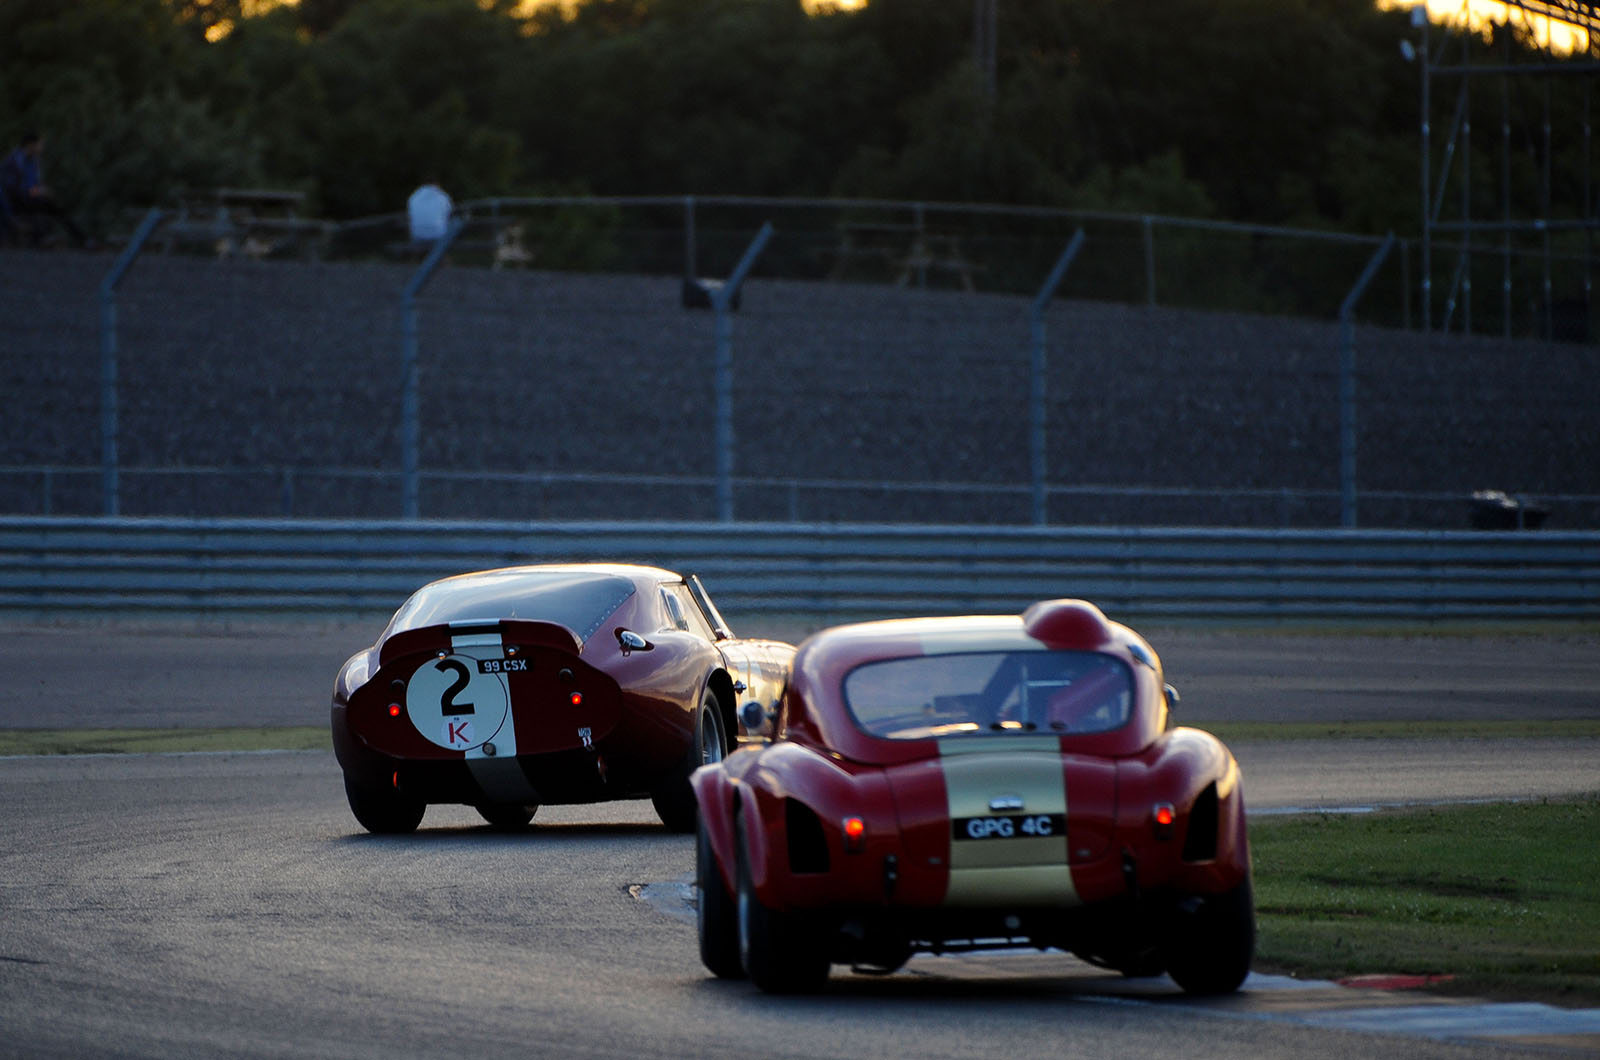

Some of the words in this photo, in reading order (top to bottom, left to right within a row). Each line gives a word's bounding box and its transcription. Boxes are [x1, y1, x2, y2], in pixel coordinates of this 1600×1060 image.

[484, 660, 500, 673] 99
[503, 659, 527, 671] CSX
[434, 658, 475, 716] 2
[448, 721, 470, 744] K
[967, 818, 1014, 838] GPG
[1021, 815, 1052, 836] 4C
